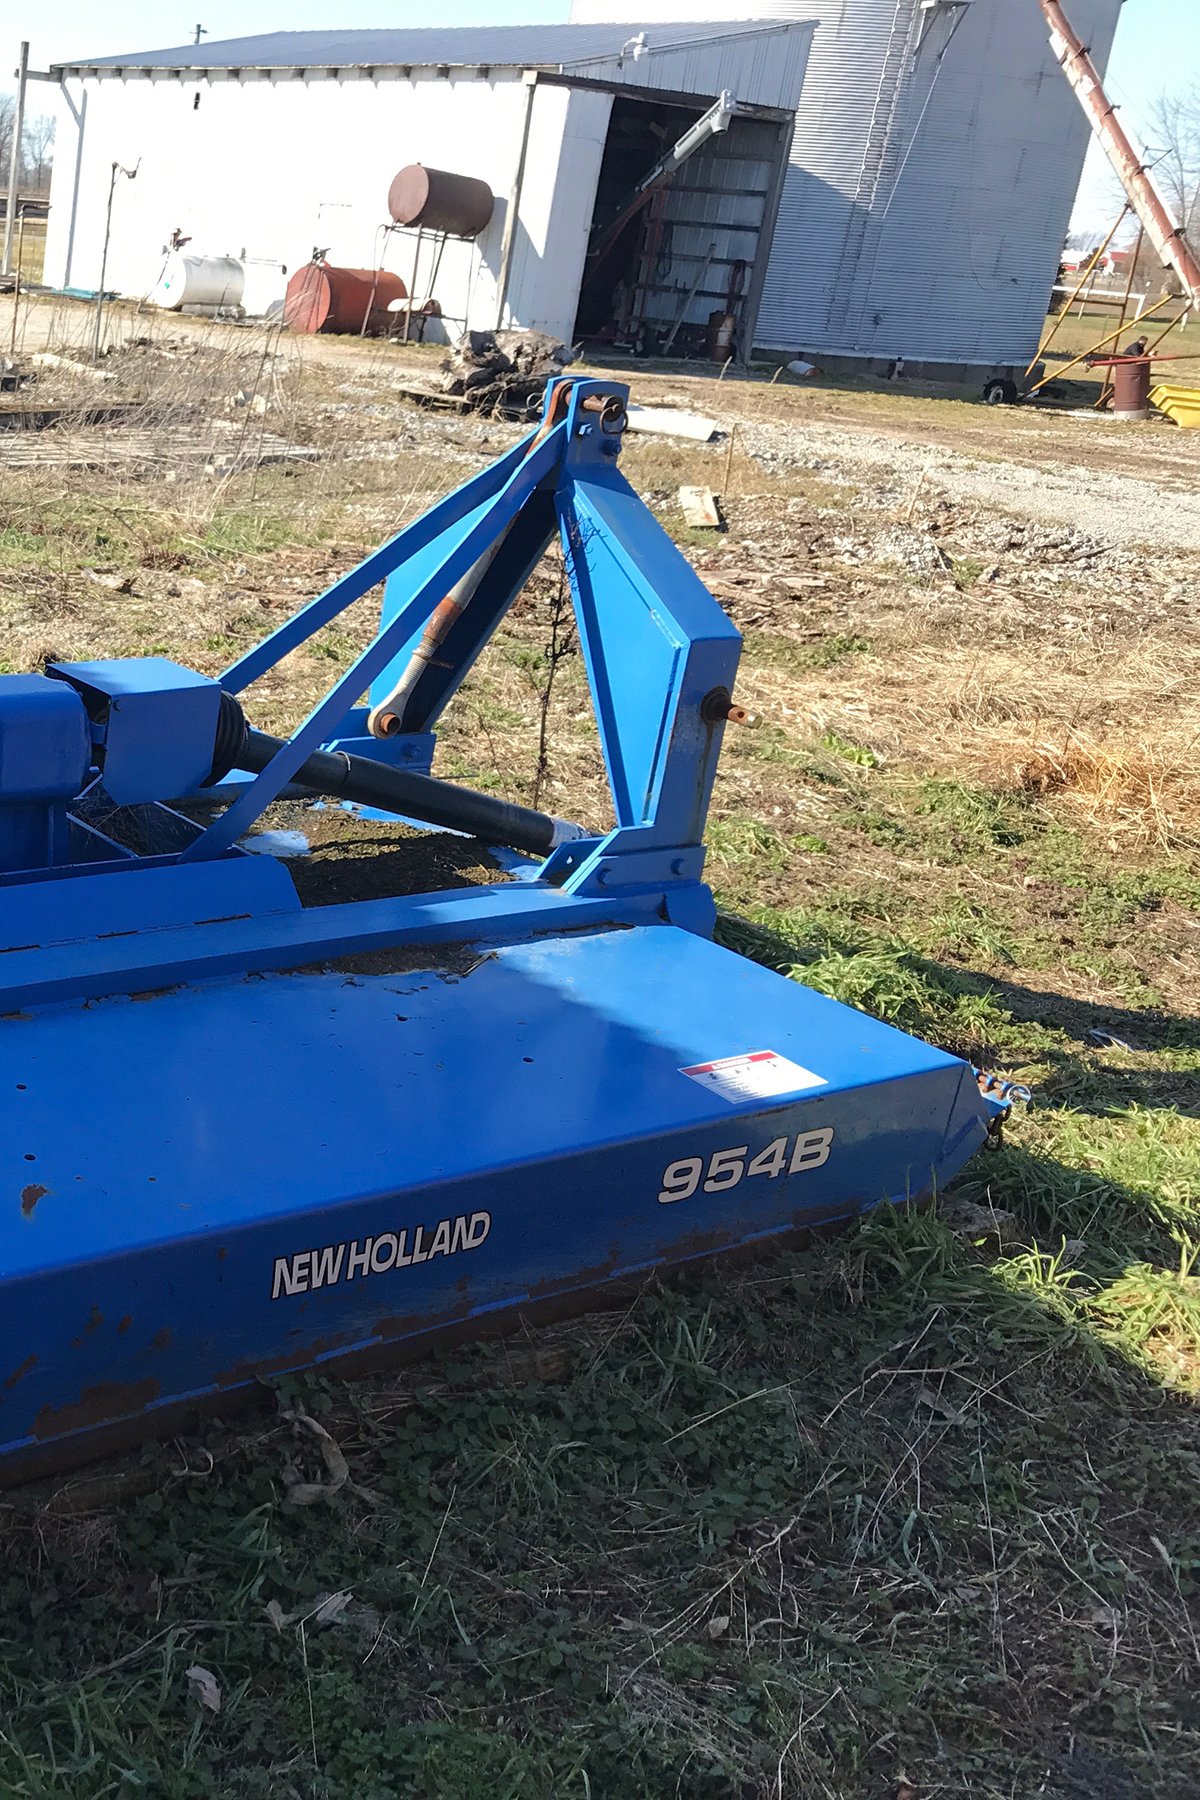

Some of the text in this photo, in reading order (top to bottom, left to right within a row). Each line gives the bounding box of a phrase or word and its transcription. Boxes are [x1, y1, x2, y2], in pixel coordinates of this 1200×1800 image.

[657, 1126, 835, 1204] 954B
[270, 1210, 491, 1300] NEW HOLLAND
